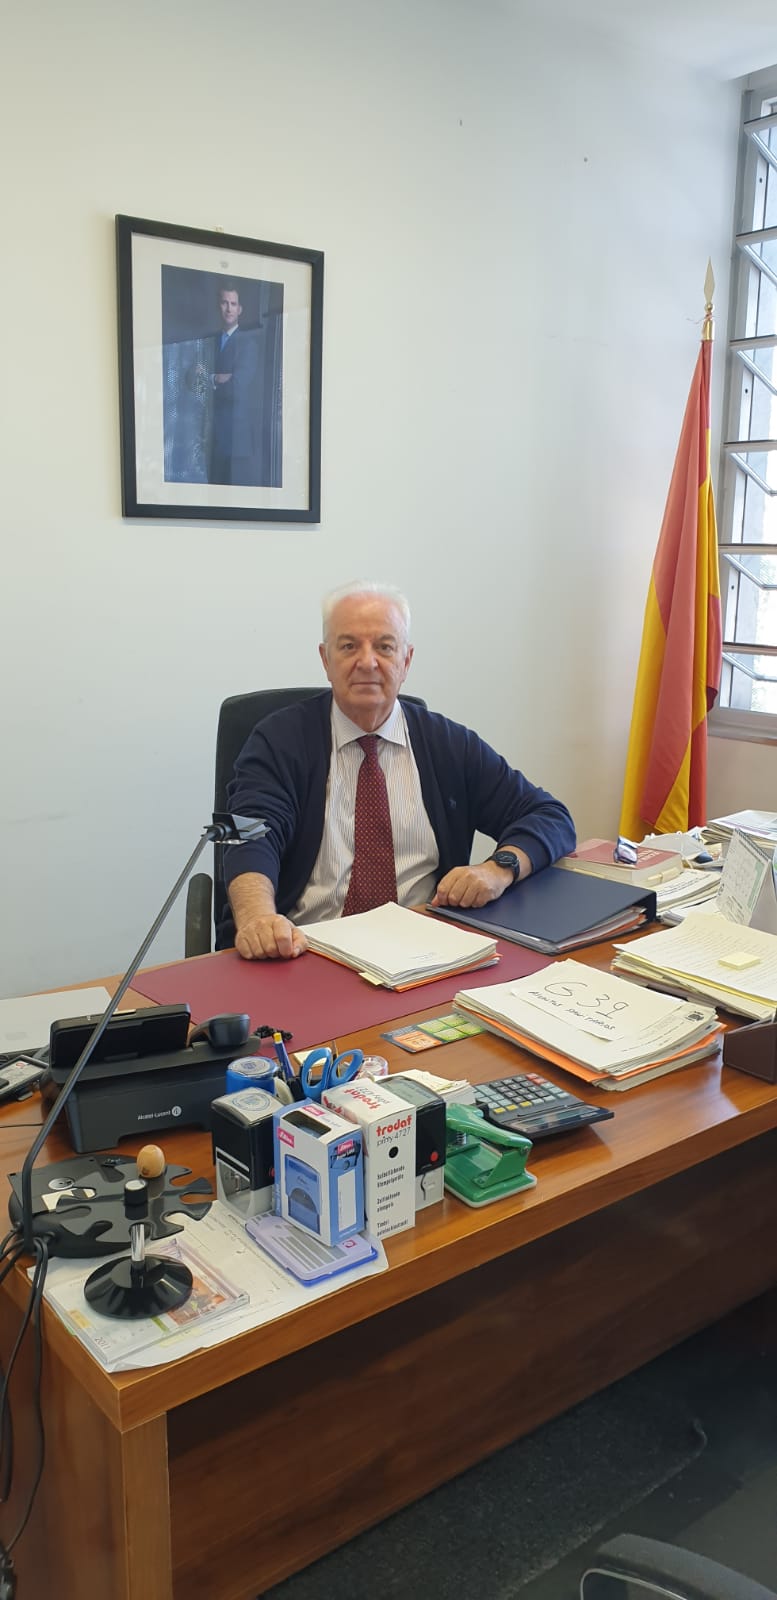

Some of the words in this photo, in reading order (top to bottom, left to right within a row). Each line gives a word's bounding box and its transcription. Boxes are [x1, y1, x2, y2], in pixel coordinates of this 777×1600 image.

[544, 982, 588, 997] G
[344, 1088, 380, 1110] trodat
[376, 1115, 412, 1137] trodat
[394, 1127, 411, 1139] 4727
